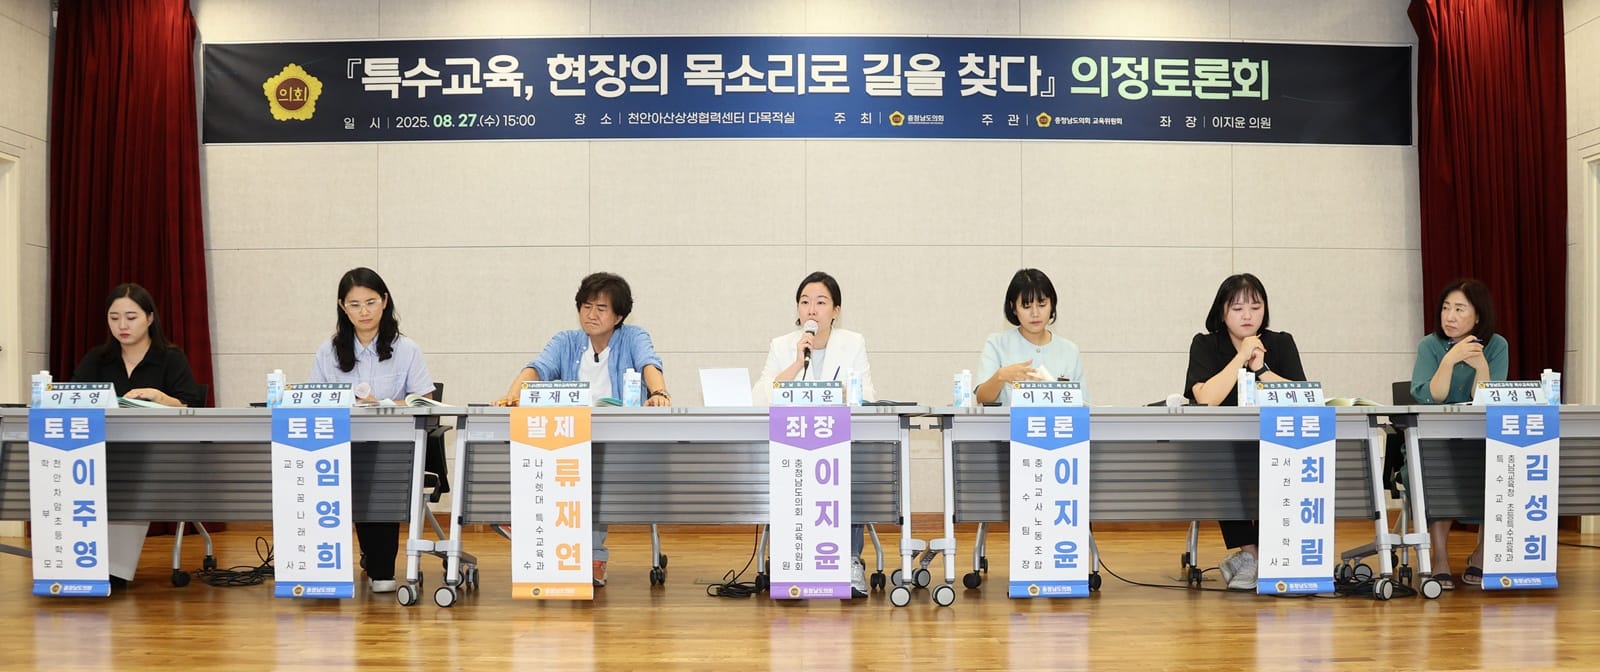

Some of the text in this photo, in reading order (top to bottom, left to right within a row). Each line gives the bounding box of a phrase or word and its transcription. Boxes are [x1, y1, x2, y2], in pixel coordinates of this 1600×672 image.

[347, 53, 1269, 101] 『특수교육, 현장의 목소리로 길을 찾다』 의정토론회
[279, 86, 307, 102] 의회
[396, 116, 430, 128] 2025.
[433, 114, 455, 128] 08.
[503, 114, 535, 127] 15:00
[628, 112, 745, 124] 천안아산상생협력센터
[749, 112, 795, 124] 다목적실
[1212, 116, 1245, 129] 이지윤
[1249, 117, 1271, 129] 의원
[44, 417, 89, 439] 토론
[288, 417, 334, 439] 토론
[527, 416, 575, 438] 발제
[786, 416, 836, 438] 좌장
[1027, 416, 1073, 438] 토론
[1275, 416, 1320, 437] 토론
[1501, 414, 1544, 436] 토론
[72, 459, 98, 568] 이주영
[315, 459, 341, 569] 임영희
[555, 458, 581, 570] 류재연
[815, 458, 840, 570] 이지윤
[1053, 458, 1078, 569] 이지윤
[1300, 456, 1325, 566] 최혜림
[1523, 455, 1548, 561] 김성희
